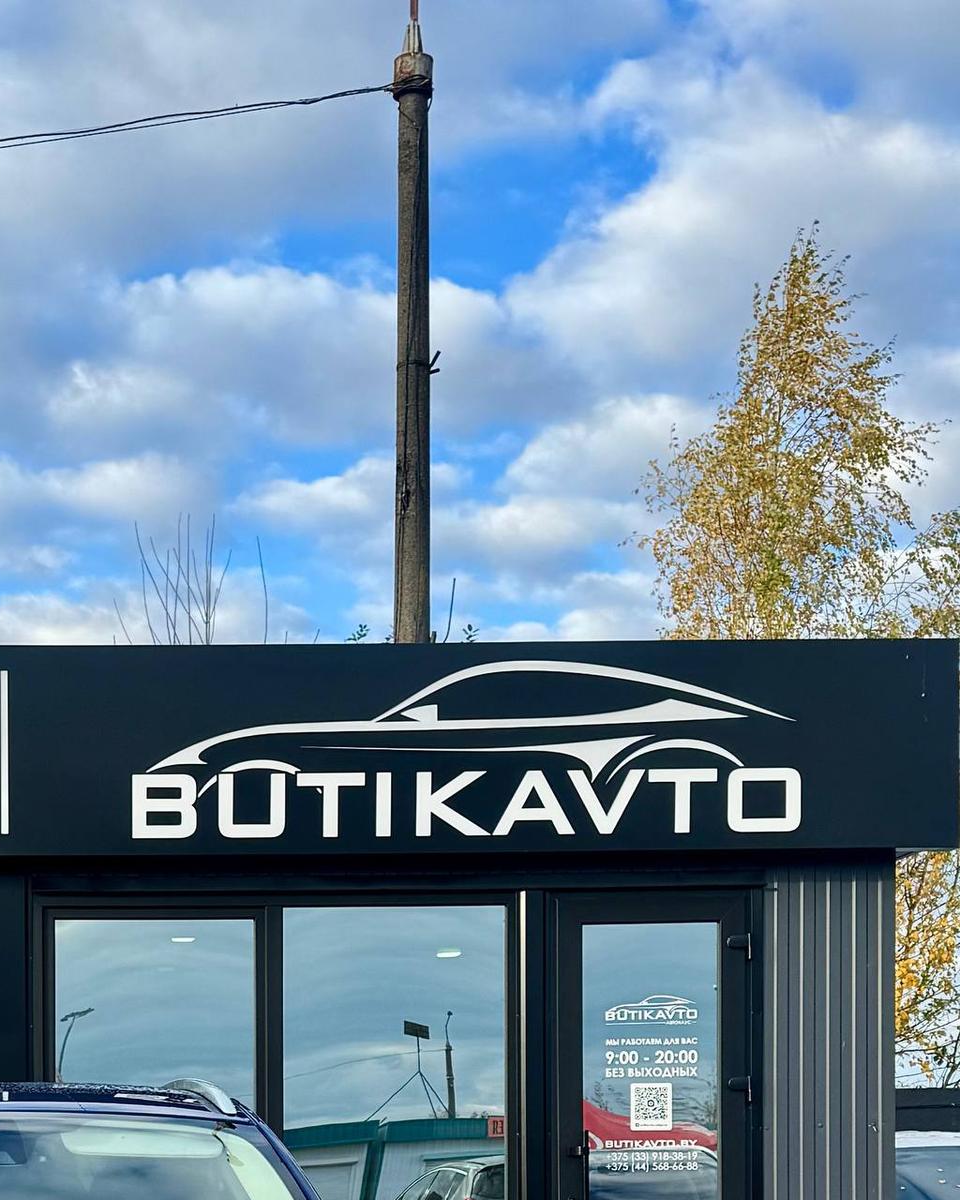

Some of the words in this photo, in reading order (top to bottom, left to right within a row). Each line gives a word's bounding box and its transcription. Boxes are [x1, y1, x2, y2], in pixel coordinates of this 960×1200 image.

[132, 767, 801, 839] BUTIKAVTO
[605, 1009, 697, 1021] BUTIKAVTO
[621, 1038, 662, 1046] РАБОТАЕМ
[663, 1038, 679, 1046] ДЛЯ
[605, 1051, 638, 1064] 9:00
[655, 1050, 698, 1064] 20:00
[605, 1068, 625, 1078] БЕЗ
[628, 1067, 698, 1078] ВЫХОДНЫХ
[605, 1139, 697, 1149] BUTIKAVTO.BY
[606, 1152, 628, 1162] +375
[632, 1152, 649, 1163] (33)
[652, 1152, 698, 1161] 918-38-19
[605, 1162, 628, 1172] +375
[632, 1162, 649, 1173] (44)
[652, 1162, 698, 1171] 568-66-88
